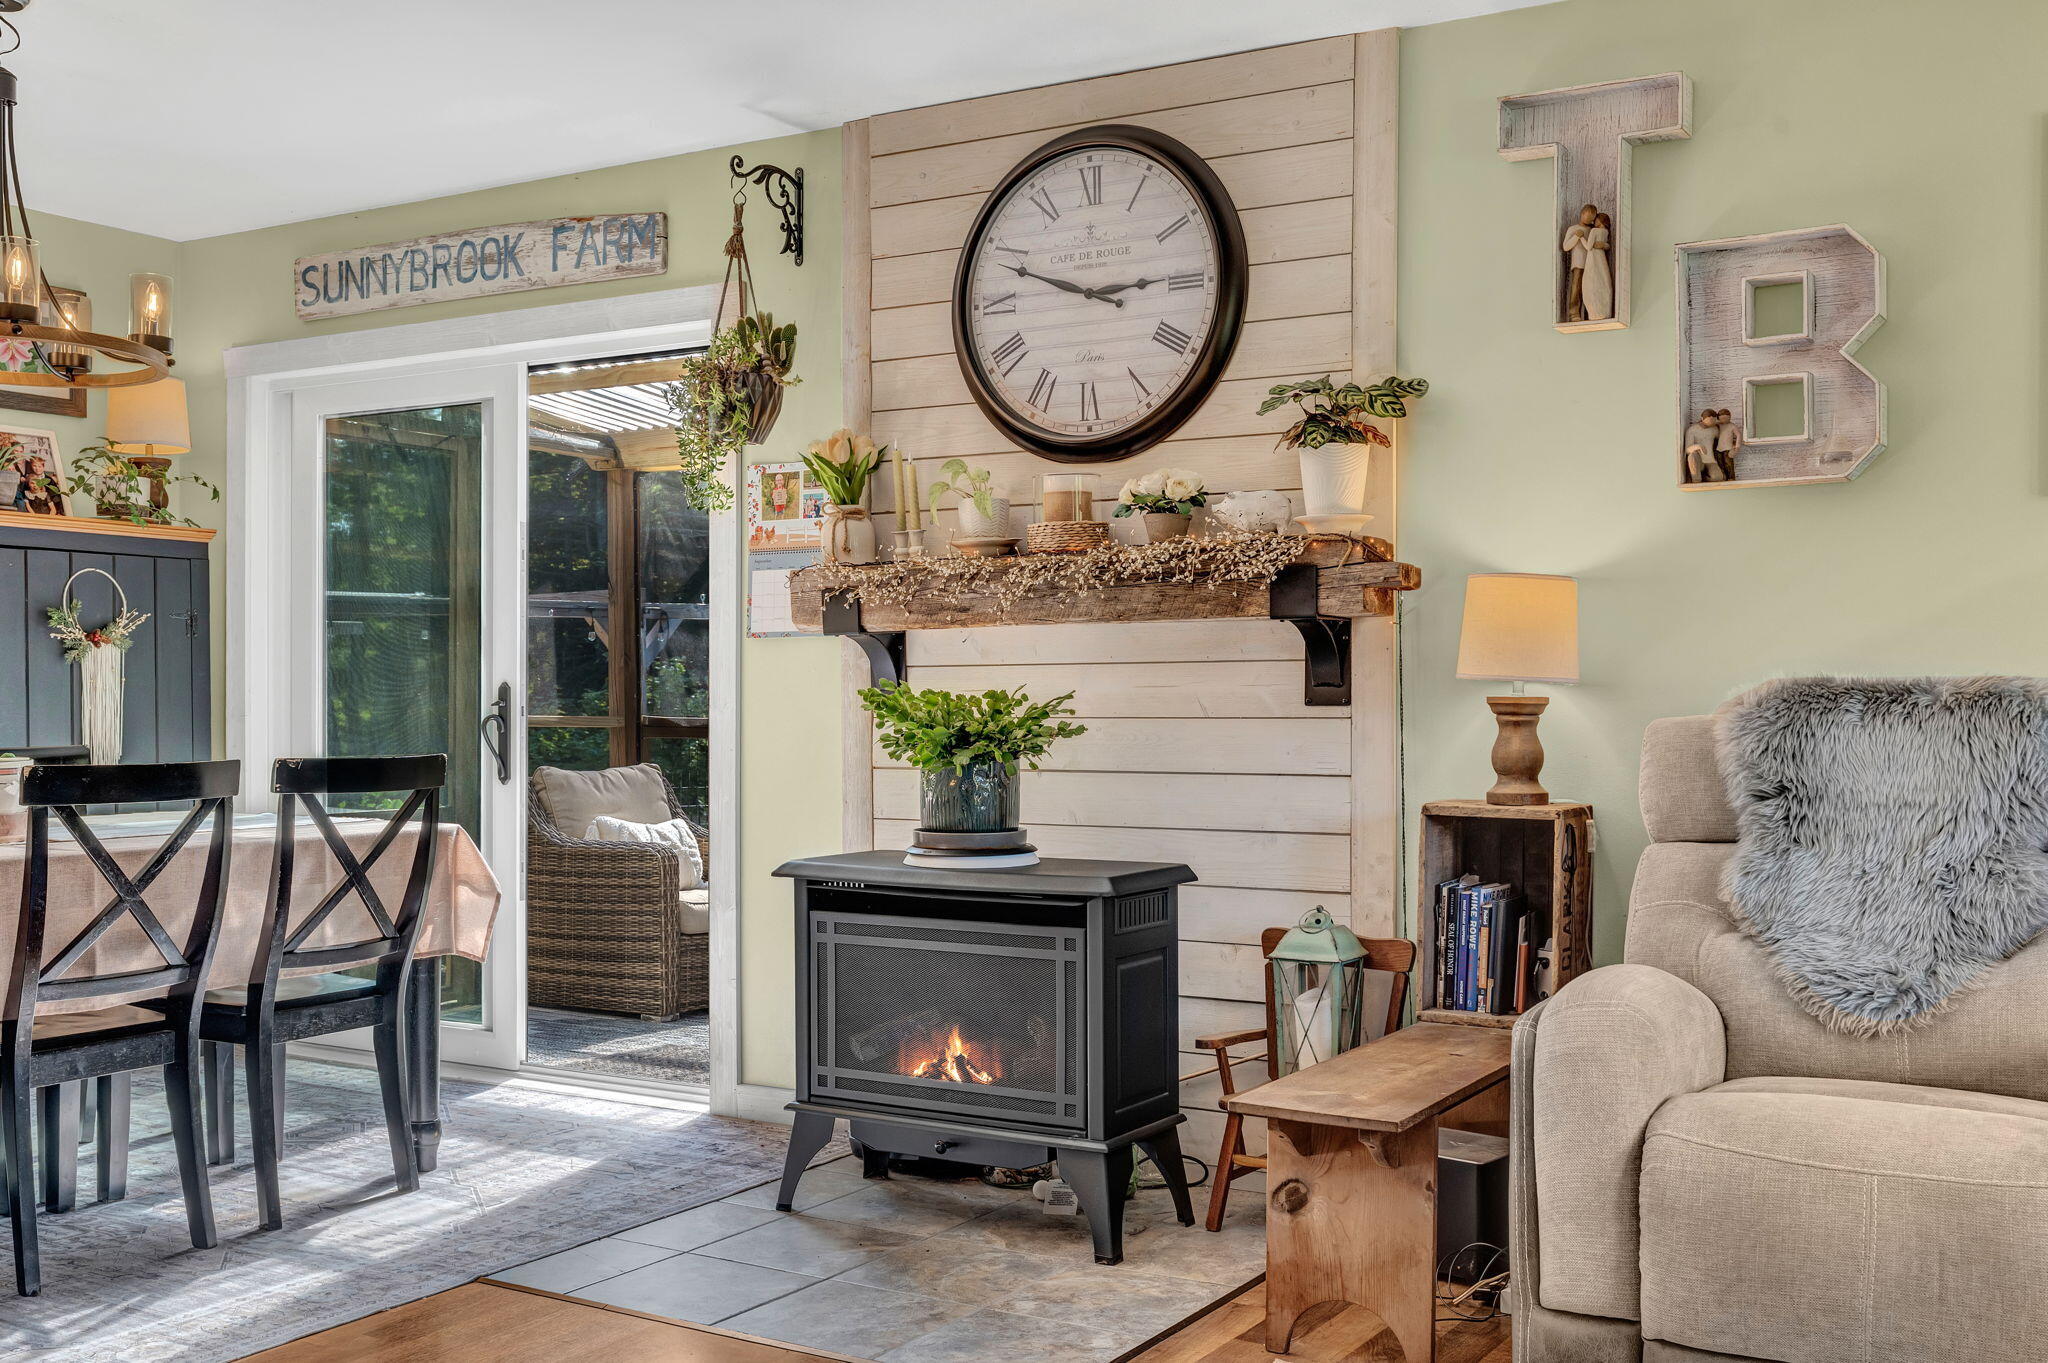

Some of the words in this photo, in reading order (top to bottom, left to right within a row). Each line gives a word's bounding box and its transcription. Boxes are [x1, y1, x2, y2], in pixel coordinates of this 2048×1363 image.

[1077, 165, 1104, 208] XII
[1497, 71, 1692, 334] T
[300, 231, 525, 308] SUNNYBROOK
[551, 213, 657, 272] FARM
[1050, 253, 1076, 265] CAFE
[1079, 251, 1093, 261] DE
[1096, 246, 1132, 259] ROUGE
[1074, 349, 1105, 364] Paris
[1673, 222, 1888, 491] B
[1470, 891, 1479, 918] MIKE
[1447, 939, 1455, 949] OF
[1468, 920, 1477, 950] ROWE
[1446, 950, 1454, 975] HONOR
